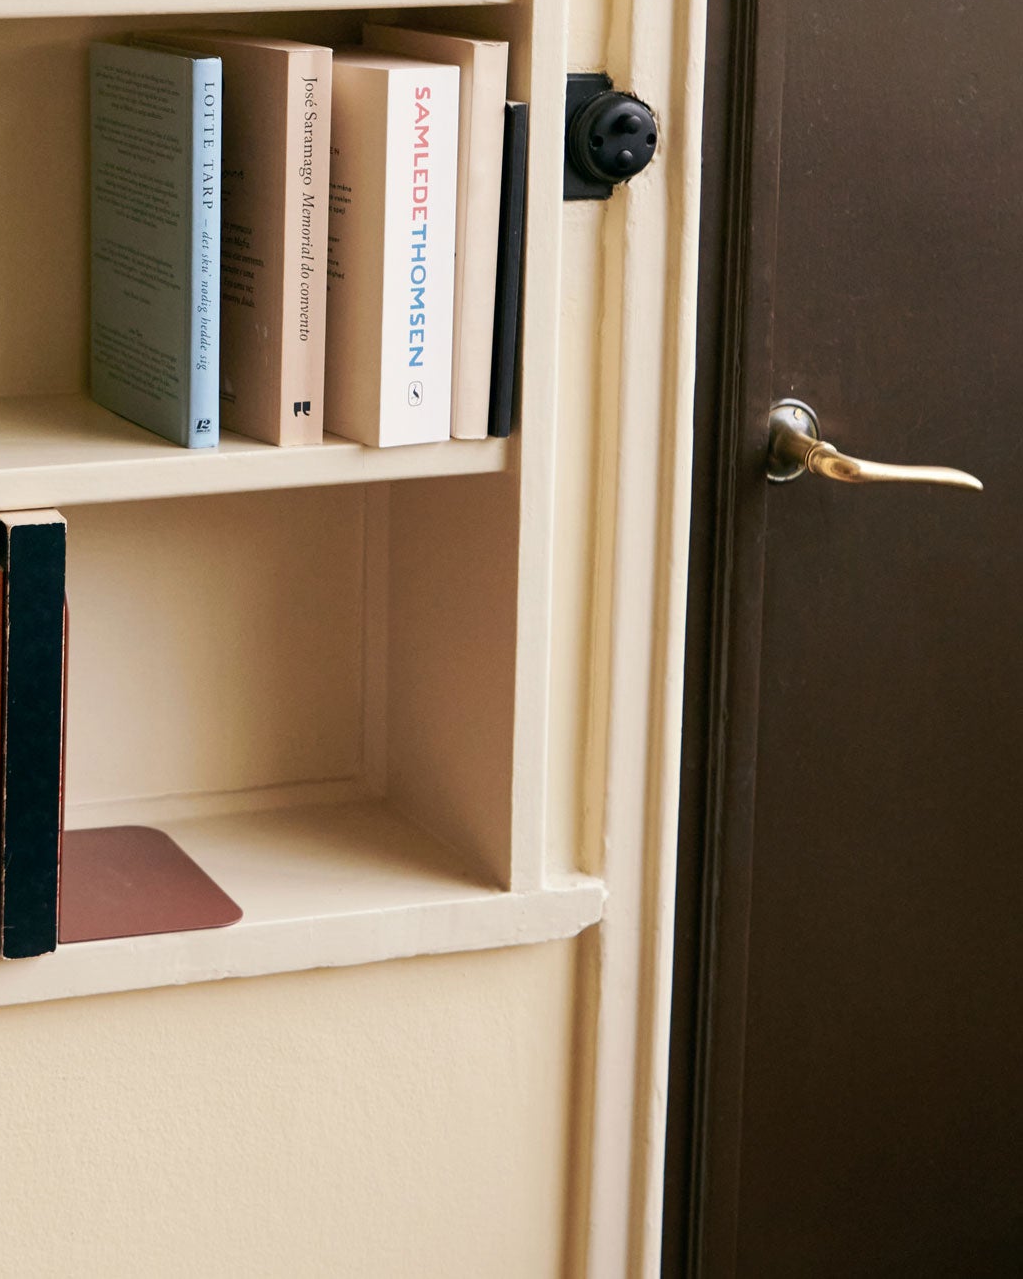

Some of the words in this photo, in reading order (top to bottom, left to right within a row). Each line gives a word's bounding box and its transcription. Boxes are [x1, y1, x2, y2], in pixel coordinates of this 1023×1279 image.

[203, 82, 215, 149] LOTTE
[301, 76, 318, 108] José
[298, 112, 318, 186] Saramago
[412, 86, 432, 222] SAMLEDE
[202, 159, 214, 210] TARP
[201, 231, 213, 250] det
[299, 192, 316, 259] Memorial
[299, 263, 315, 279] do
[408, 224, 428, 368] THOMSEN
[199, 316, 212, 352] hedde
[298, 282, 313, 342] convento
[196, 354, 210, 371] sig
